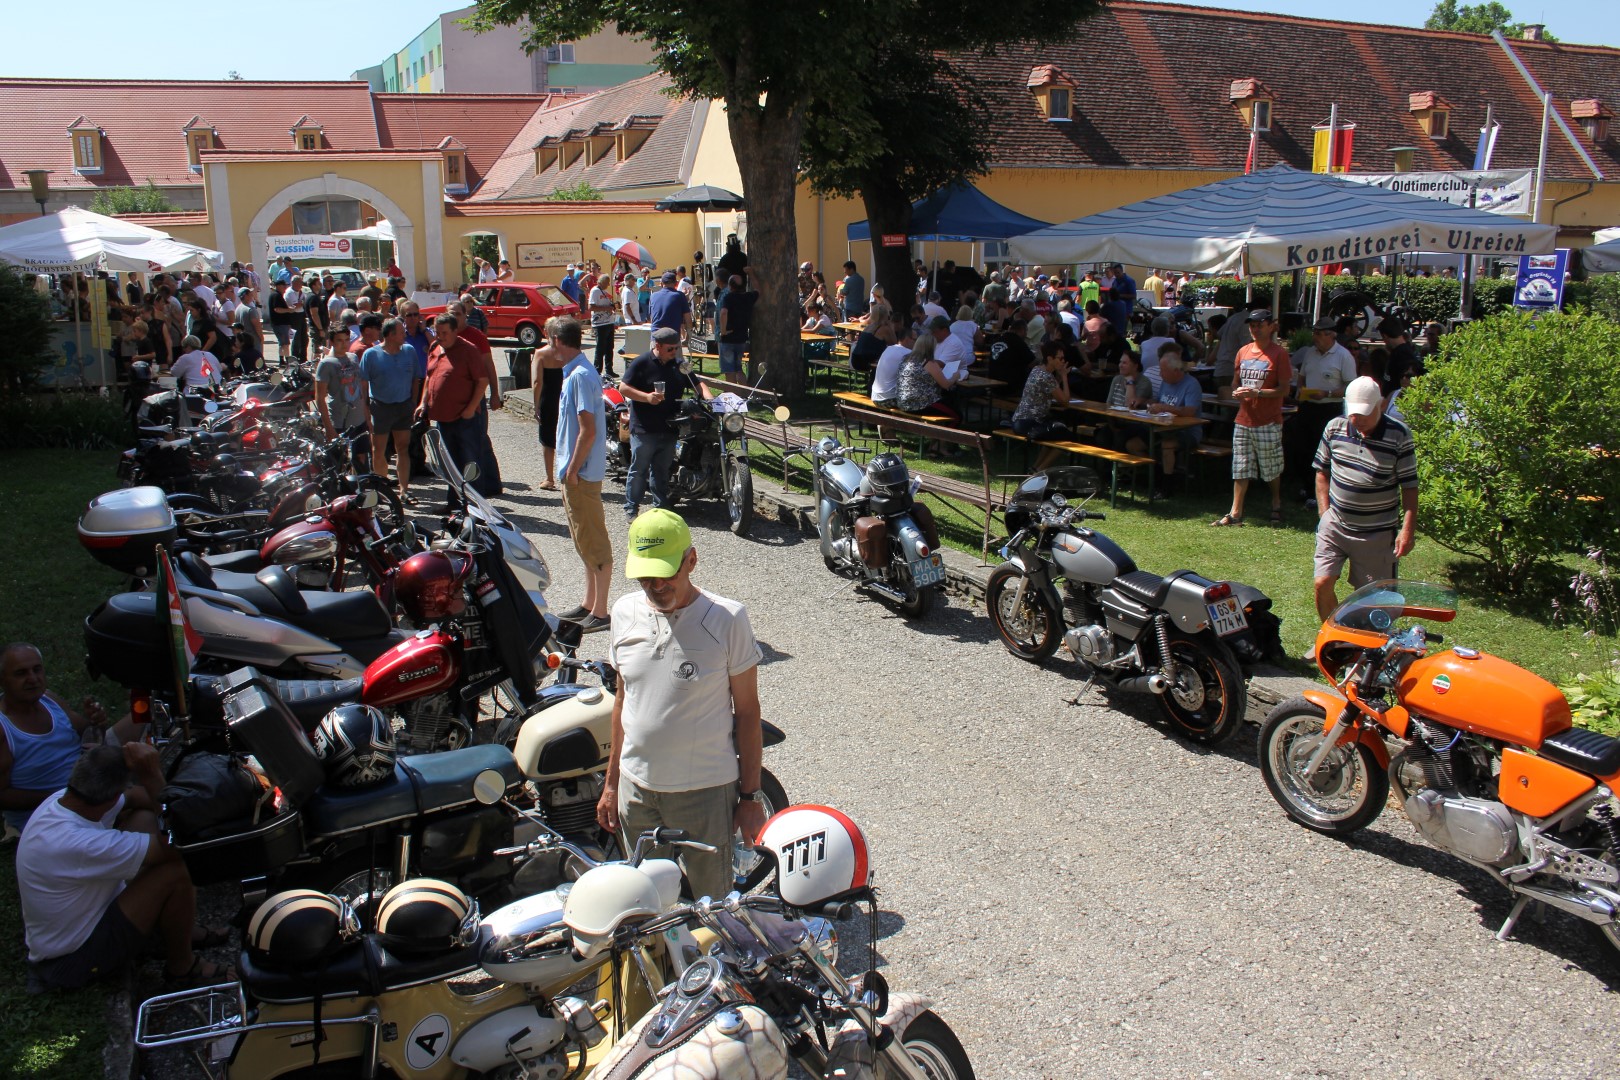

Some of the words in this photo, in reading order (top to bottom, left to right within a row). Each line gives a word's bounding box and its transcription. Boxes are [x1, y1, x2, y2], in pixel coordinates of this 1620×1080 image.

[1392, 179, 1469, 192] Oldtimerclub
[274, 237, 315, 246] Haustechnik
[1286, 227, 1421, 267] Konditorei
[1447, 229, 1527, 252] Ulreich
[915, 559, 932, 574] MA
[1216, 602, 1230, 616] GS
[1216, 616, 1235, 633] 774
[1234, 613, 1244, 627] M
[399, 665, 439, 682] SUZUKI
[415, 1031, 445, 1058] A
